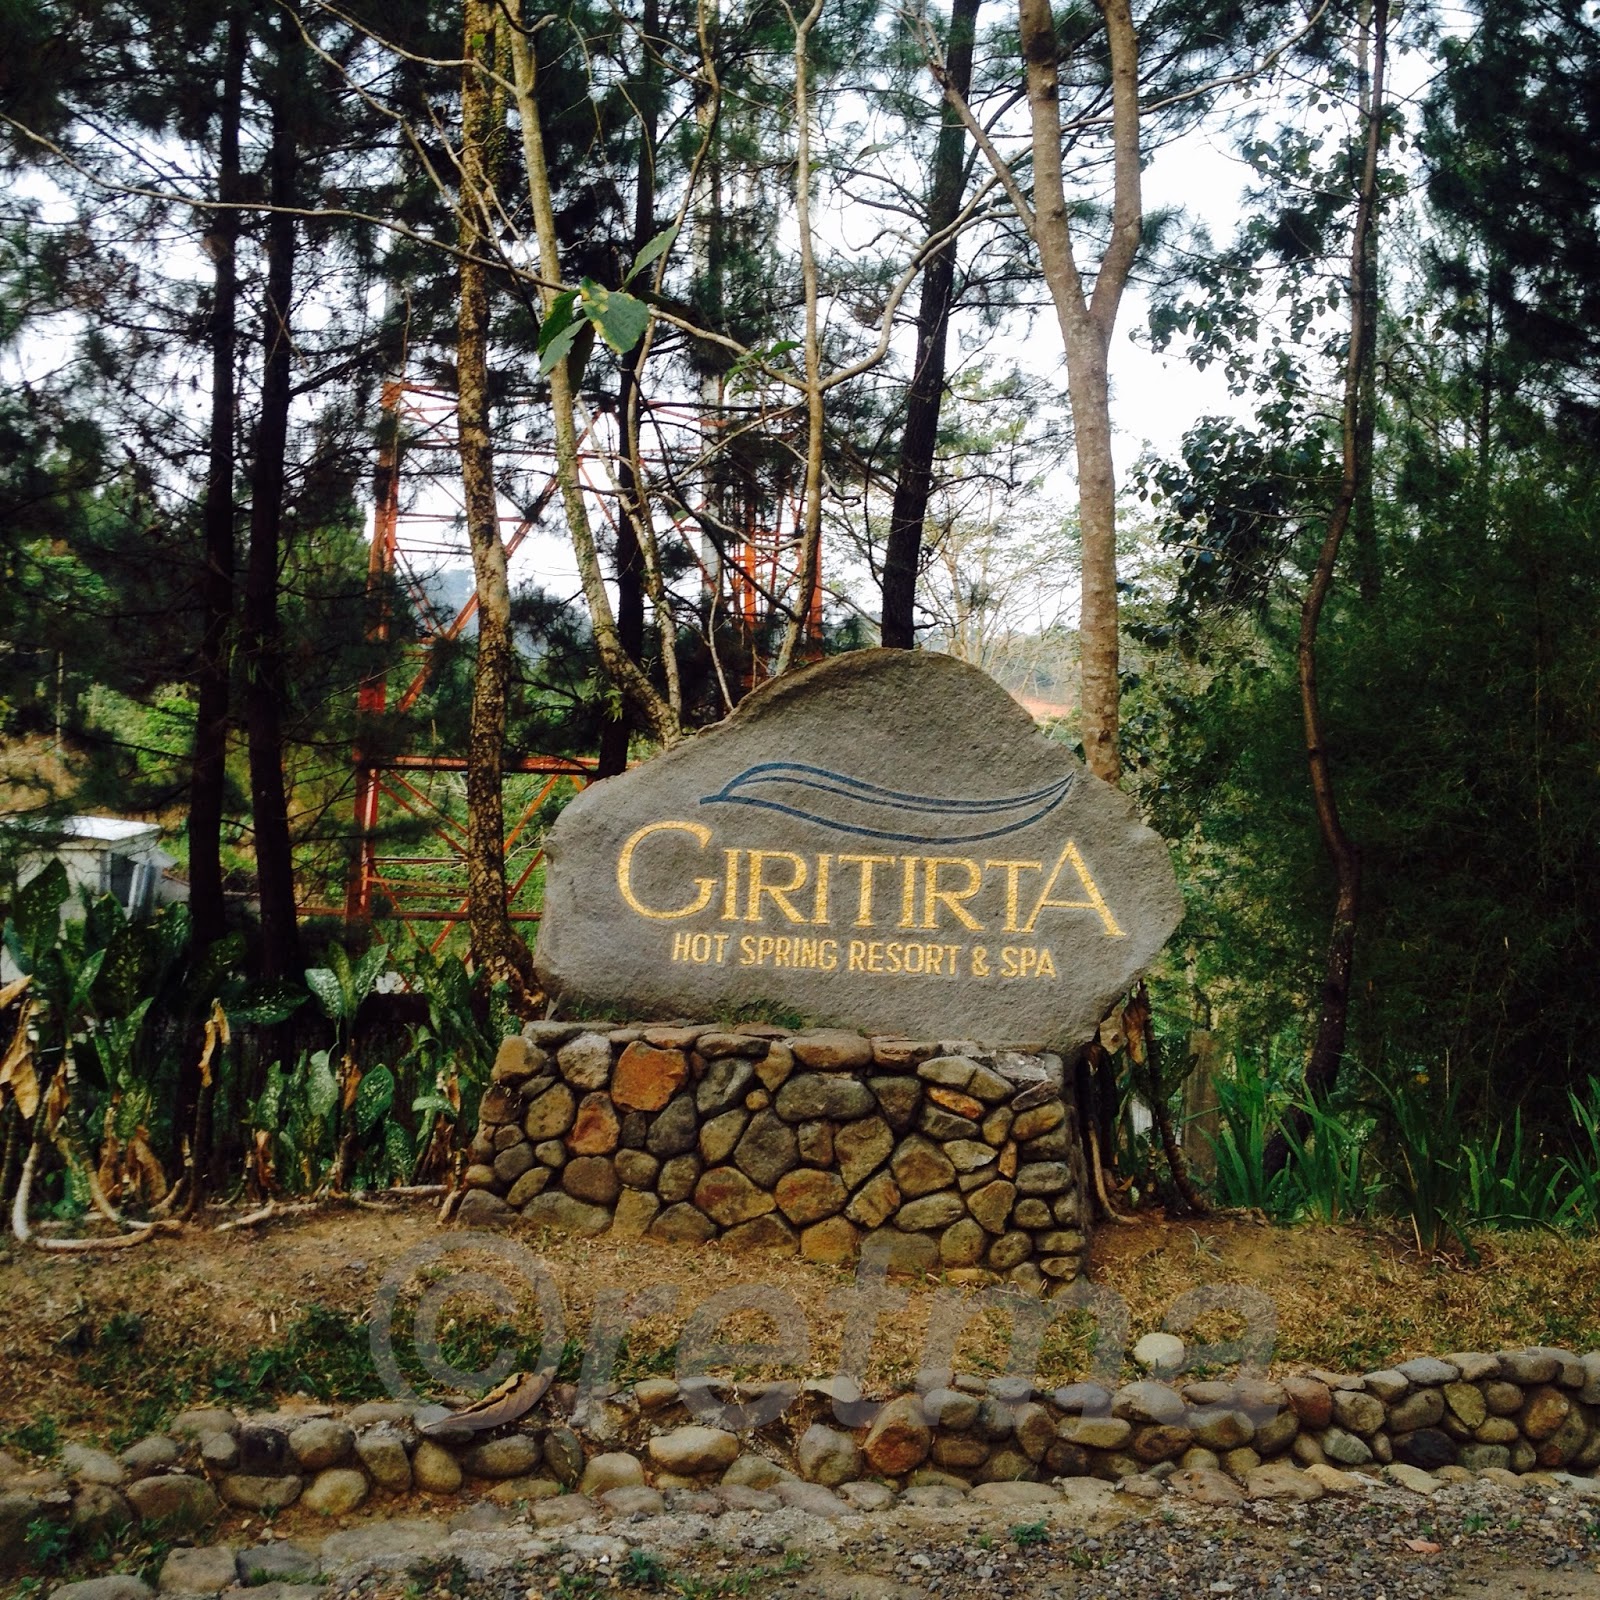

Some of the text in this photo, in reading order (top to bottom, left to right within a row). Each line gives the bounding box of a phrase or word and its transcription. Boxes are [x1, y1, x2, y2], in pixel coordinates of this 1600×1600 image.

[616, 820, 1127, 938] GIRITIRTA
[672, 932, 1057, 979] HOT SPRING RESORT & SPA
